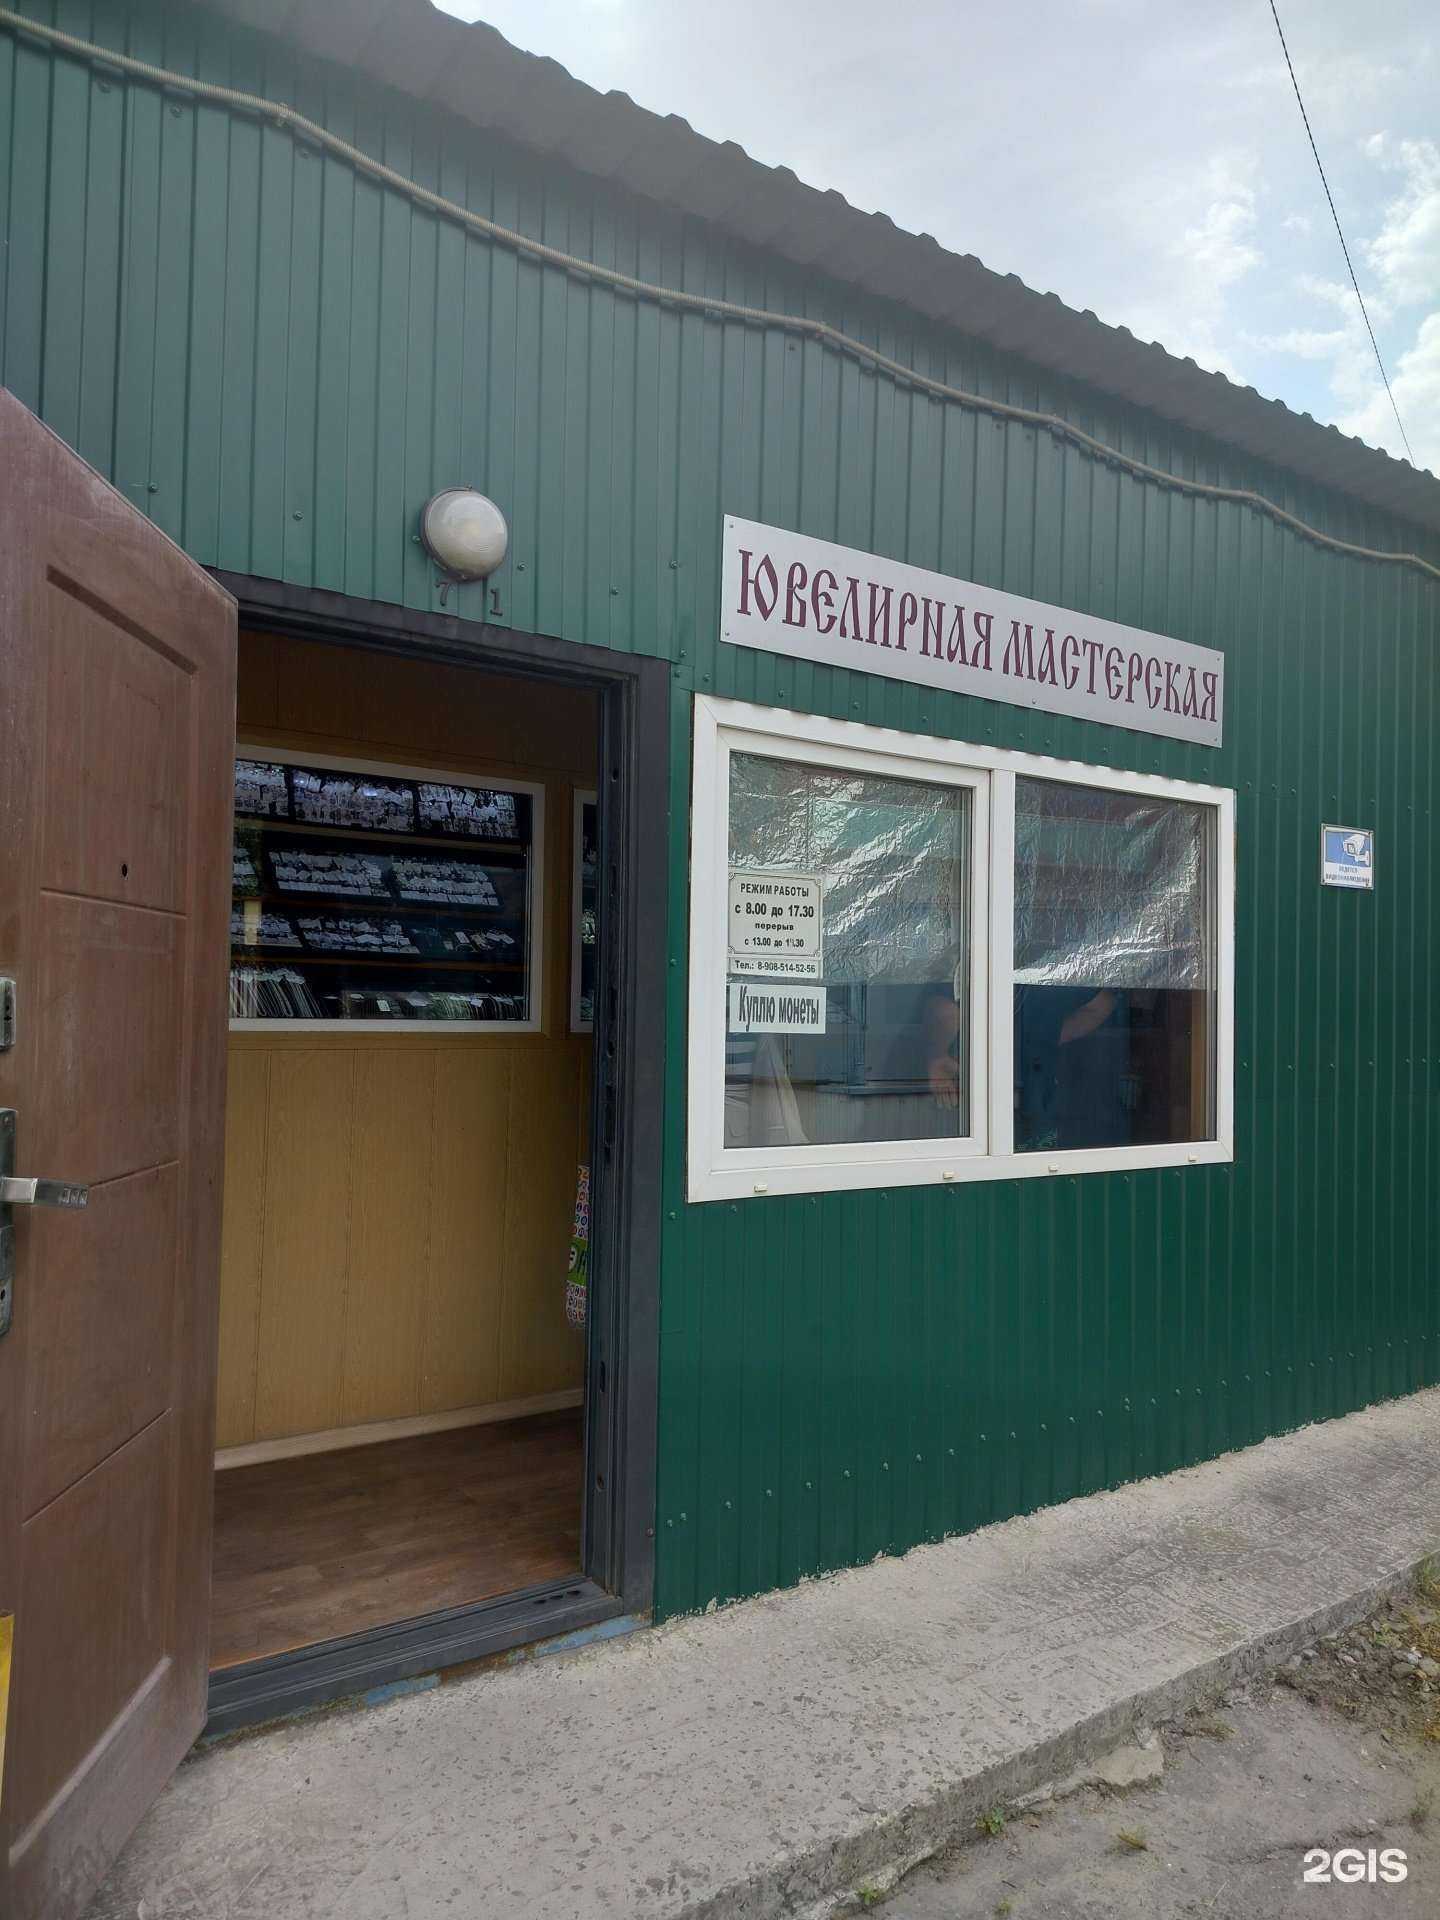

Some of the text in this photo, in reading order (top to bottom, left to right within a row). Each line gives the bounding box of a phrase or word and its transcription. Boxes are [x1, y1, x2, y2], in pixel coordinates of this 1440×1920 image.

[736, 548, 1219, 722] ЮВЕЛИРНАЯ МАСТЕРСКАЯ
[740, 883, 810, 898] РЕЖИМ РАБОТЫ
[746, 902, 767, 915] 8.00
[771, 907, 783, 918] до
[788, 905, 814, 918] 17.30
[755, 922, 794, 932] перерыв
[752, 937, 771, 947] 13.00
[774, 939, 783, 948] до
[738, 985, 819, 1032] Куплю монеты
